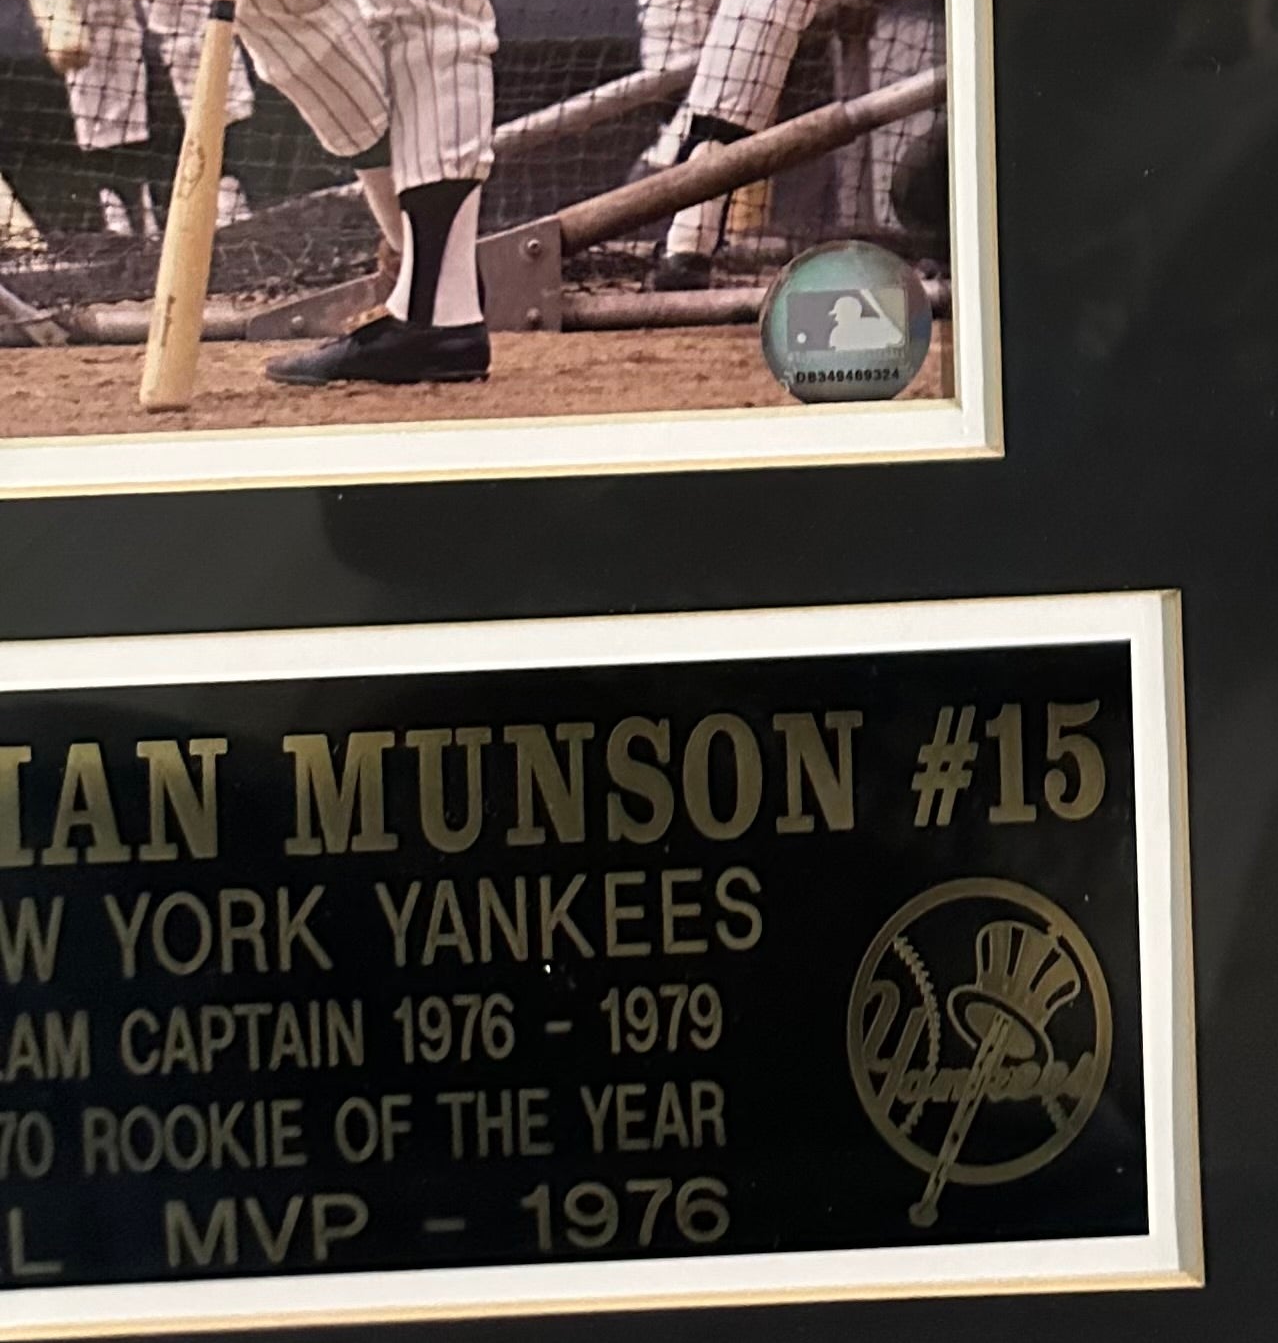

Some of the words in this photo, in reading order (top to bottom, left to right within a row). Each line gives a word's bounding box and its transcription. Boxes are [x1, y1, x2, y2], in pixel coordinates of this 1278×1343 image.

[283, 711, 864, 857] MUNSON
[912, 698, 1108, 828] #15
[105, 883, 334, 980] YORK
[375, 865, 763, 969] YANKEES
[0, 1009, 91, 1081] AM
[120, 998, 365, 1076] CAPTAIN
[394, 993, 516, 1065] 1976
[600, 986, 724, 1053] 1979
[81, 1098, 309, 1179] ROOKIE
[336, 1091, 412, 1163] OF
[436, 1086, 553, 1158] THE
[581, 1079, 728, 1152] YEAR
[164, 1193, 370, 1268] MVP
[521, 1177, 732, 1251] 1976
